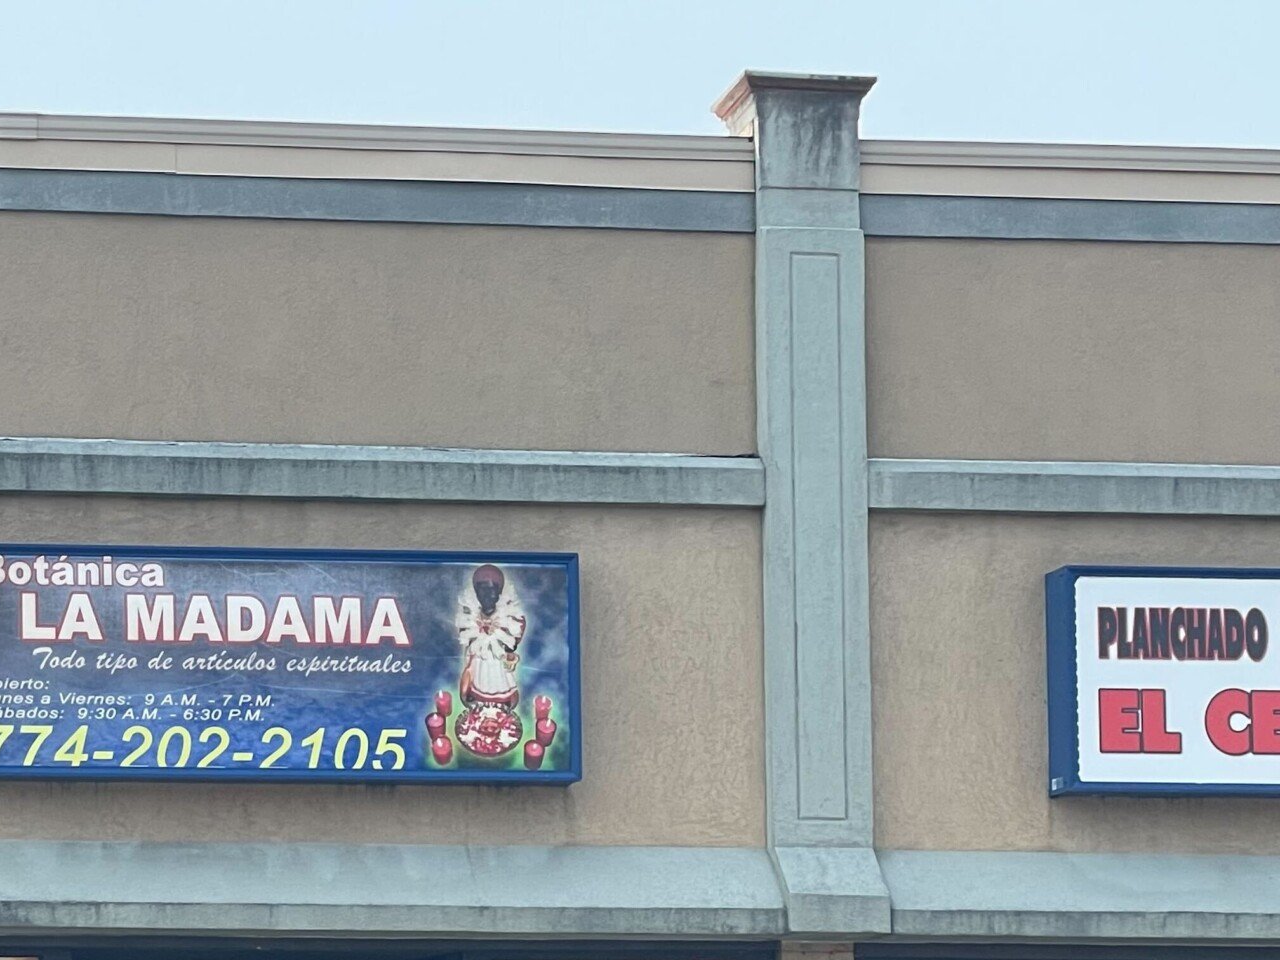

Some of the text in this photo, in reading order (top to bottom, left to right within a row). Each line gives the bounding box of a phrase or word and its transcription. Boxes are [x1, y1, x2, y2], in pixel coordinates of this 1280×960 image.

[20, 592, 411, 646] LA MADAMA
[1097, 606, 1269, 662] PLANCHADO
[32, 646, 412, 677] Todo tipo de artículos espirituales
[40, 695, 52, 705] a
[59, 692, 132, 706] Viernes:
[144, 693, 155, 706] 9
[160, 693, 200, 706] A.M.
[222, 694, 233, 707] 7
[238, 694, 275, 707] P.M.
[77, 707, 117, 720] 9:30
[122, 708, 162, 720] A.M.
[183, 708, 222, 721] 6:30
[228, 709, 265, 721] P.M.
[1098, 688, 1182, 754] EL
